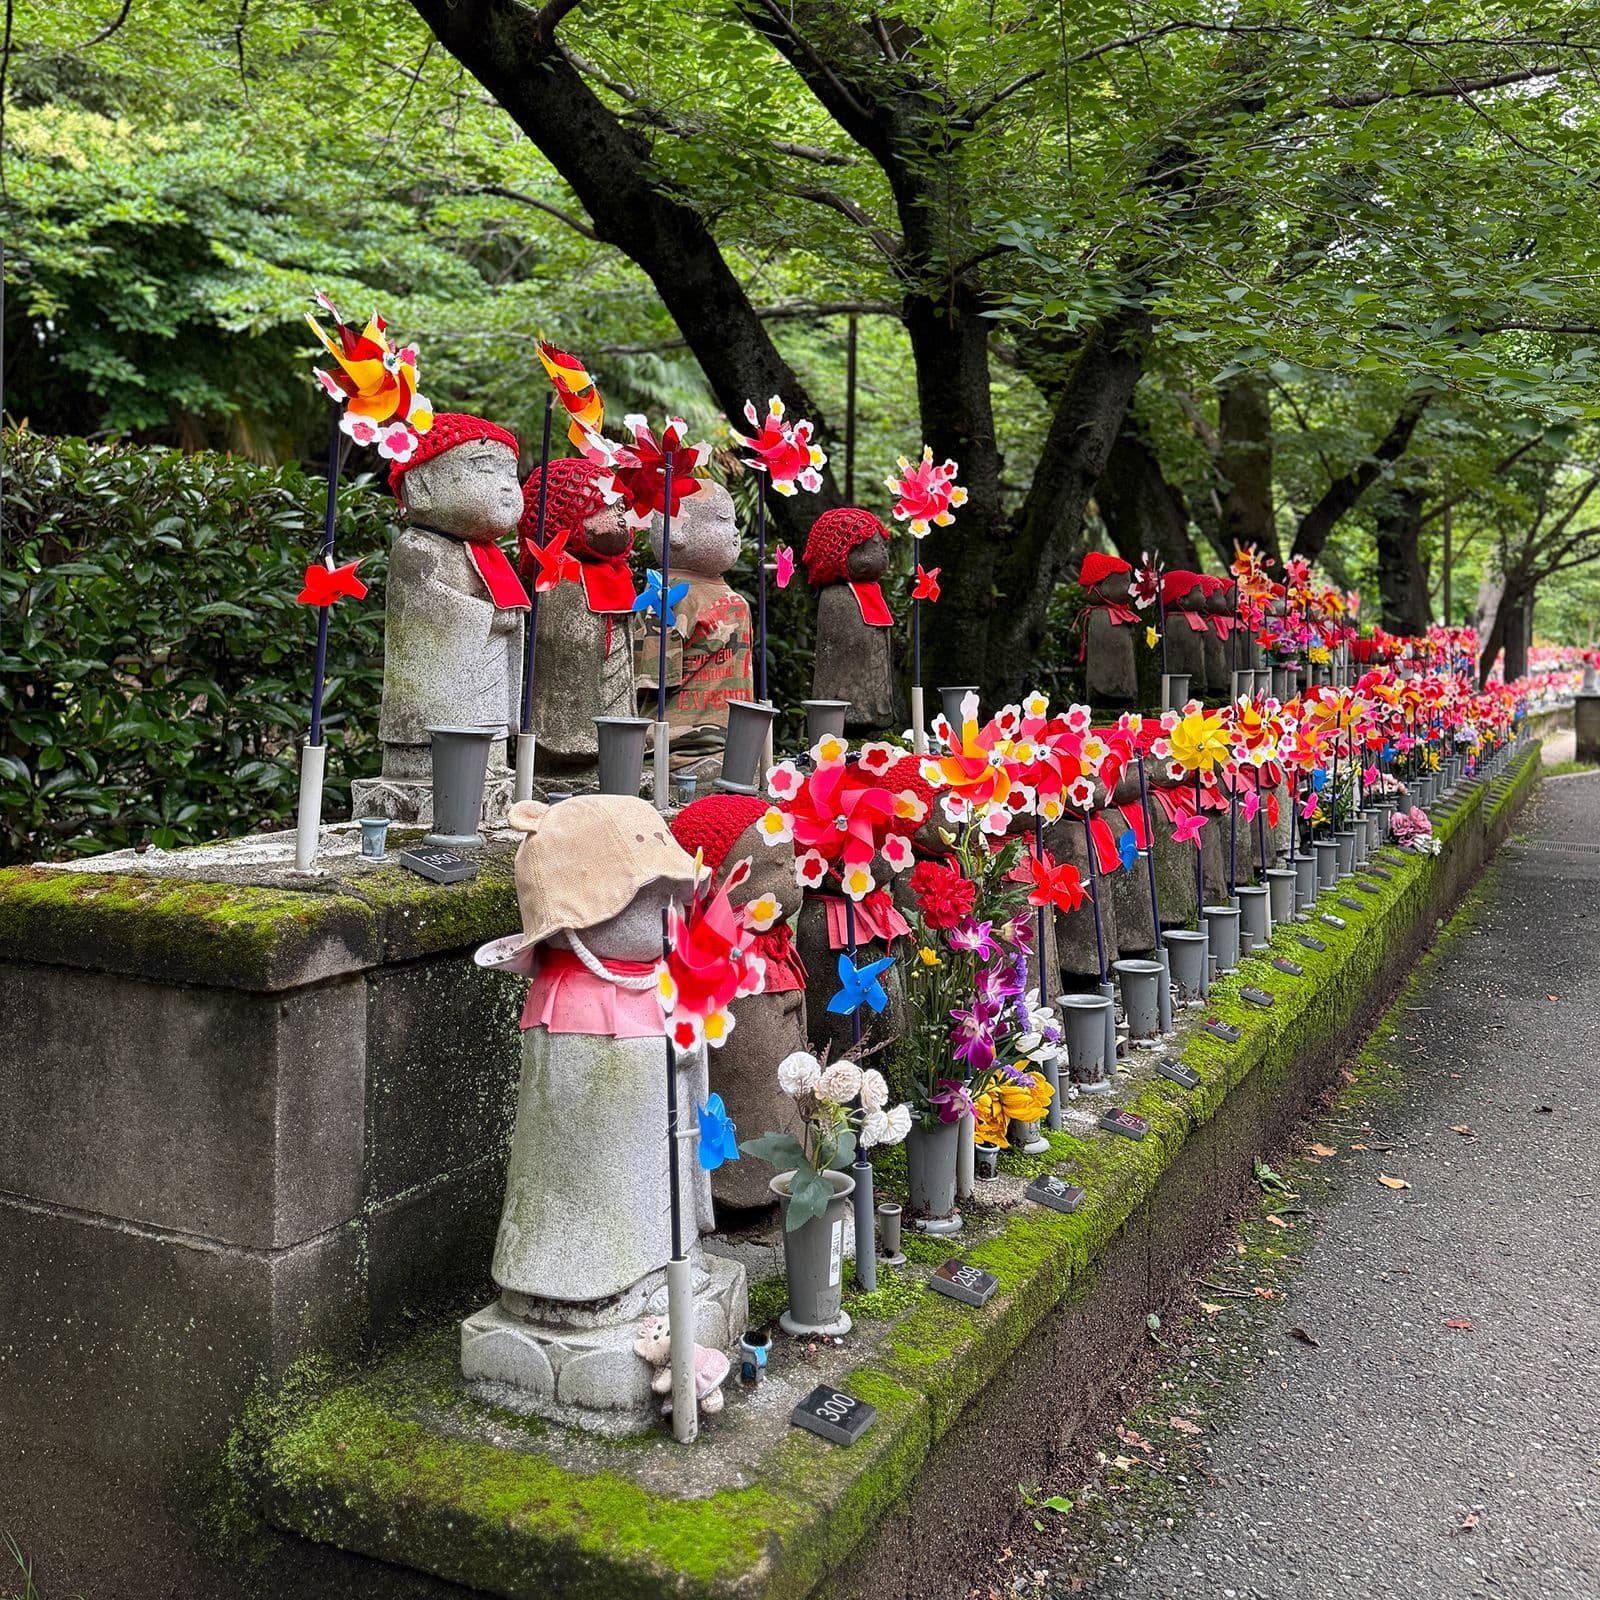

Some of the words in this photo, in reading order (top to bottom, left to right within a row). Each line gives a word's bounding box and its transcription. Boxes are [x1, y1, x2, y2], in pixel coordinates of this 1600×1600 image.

[422, 853, 461, 865] 350
[951, 1265, 982, 1287] 299
[815, 1393, 856, 1422] 300
